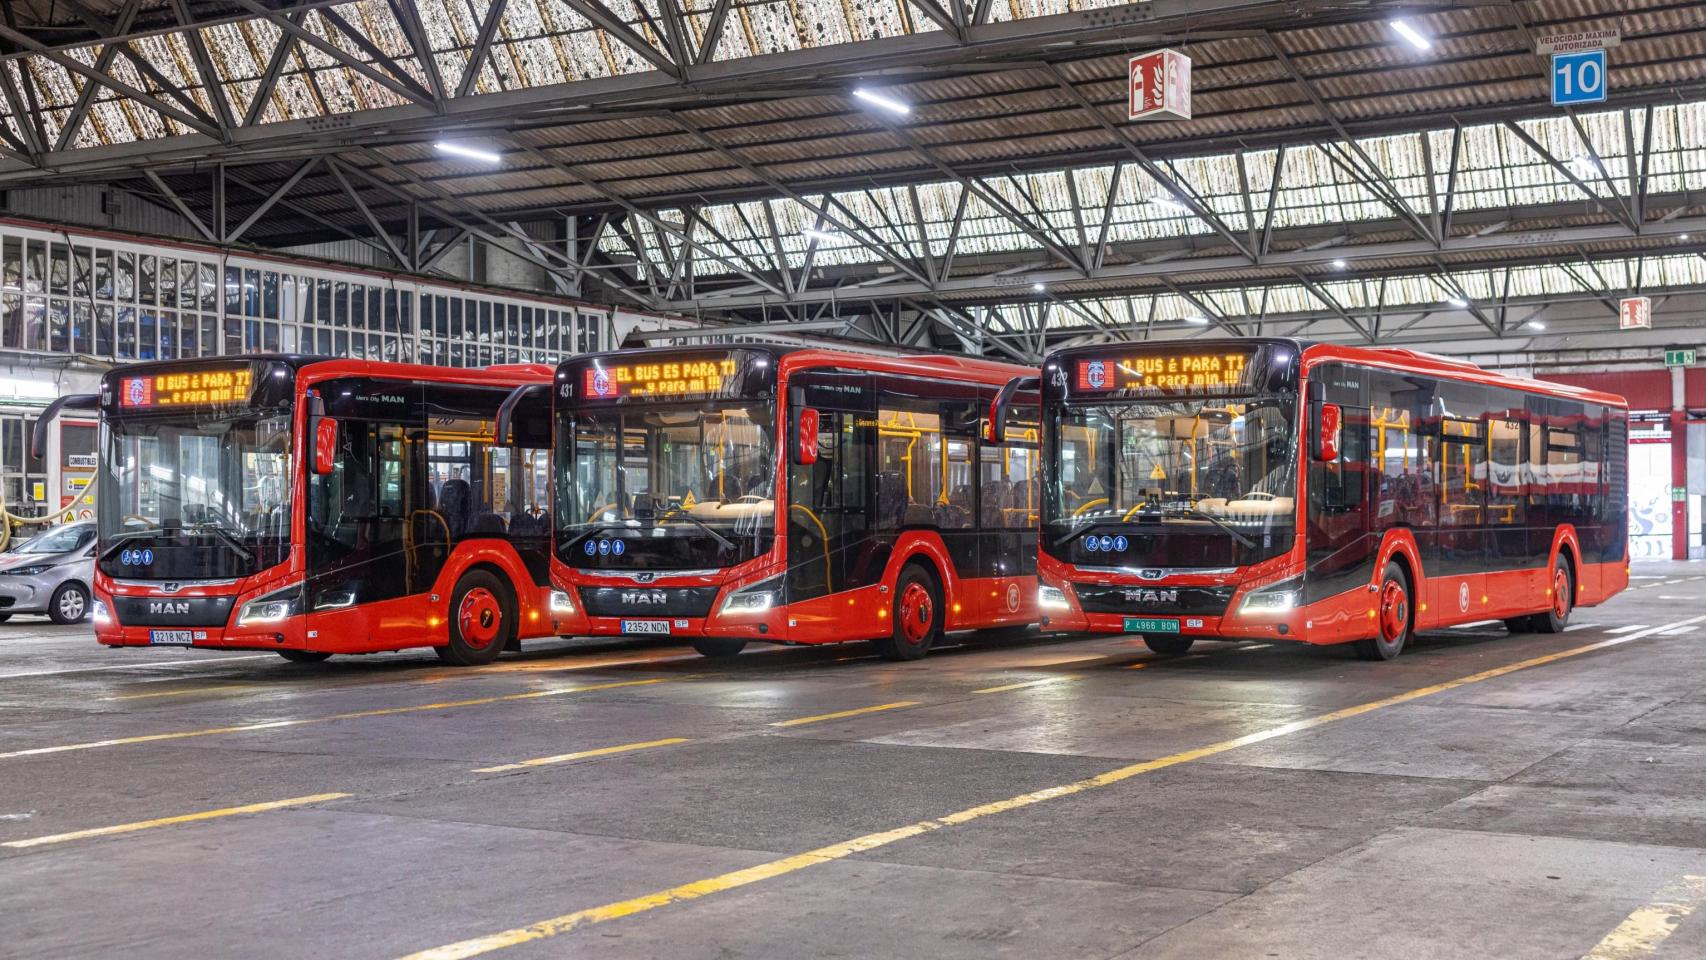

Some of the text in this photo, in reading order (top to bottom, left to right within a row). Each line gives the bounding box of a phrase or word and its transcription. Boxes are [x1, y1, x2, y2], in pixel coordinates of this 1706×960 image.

[1540, 30, 1617, 44] VELOCIDAD MAXIMA
[1554, 40, 1602, 51] AUTORIZADA
[1557, 60, 1600, 94] 10
[1136, 358, 1164, 373] BUS
[1183, 356, 1220, 371] PARA
[1226, 355, 1244, 370] TI
[617, 361, 736, 381] EL BUS ES PARA TI
[157, 378, 164, 391] O
[167, 376, 189, 389] BUS
[202, 373, 232, 387] PARA
[236, 372, 250, 385] TI
[659, 381, 685, 393] para
[708, 375, 720, 390] !!!
[1051, 371, 1068, 386] 432
[1158, 374, 1188, 386] para
[1224, 370, 1238, 384] !!!
[184, 390, 206, 402] para
[234, 386, 245, 399] !!!
[560, 384, 573, 398] 431
[843, 385, 861, 394] MAN
[381, 395, 404, 403] MAN
[70, 456, 96, 466] COMBUSTIBLES
[622, 593, 667, 604] MAN
[1125, 590, 1177, 601] MAN
[150, 602, 189, 614] MAN
[628, 623, 649, 632] 2352
[1136, 621, 1156, 630] 4966
[155, 632, 190, 642] 3218 NCZ
